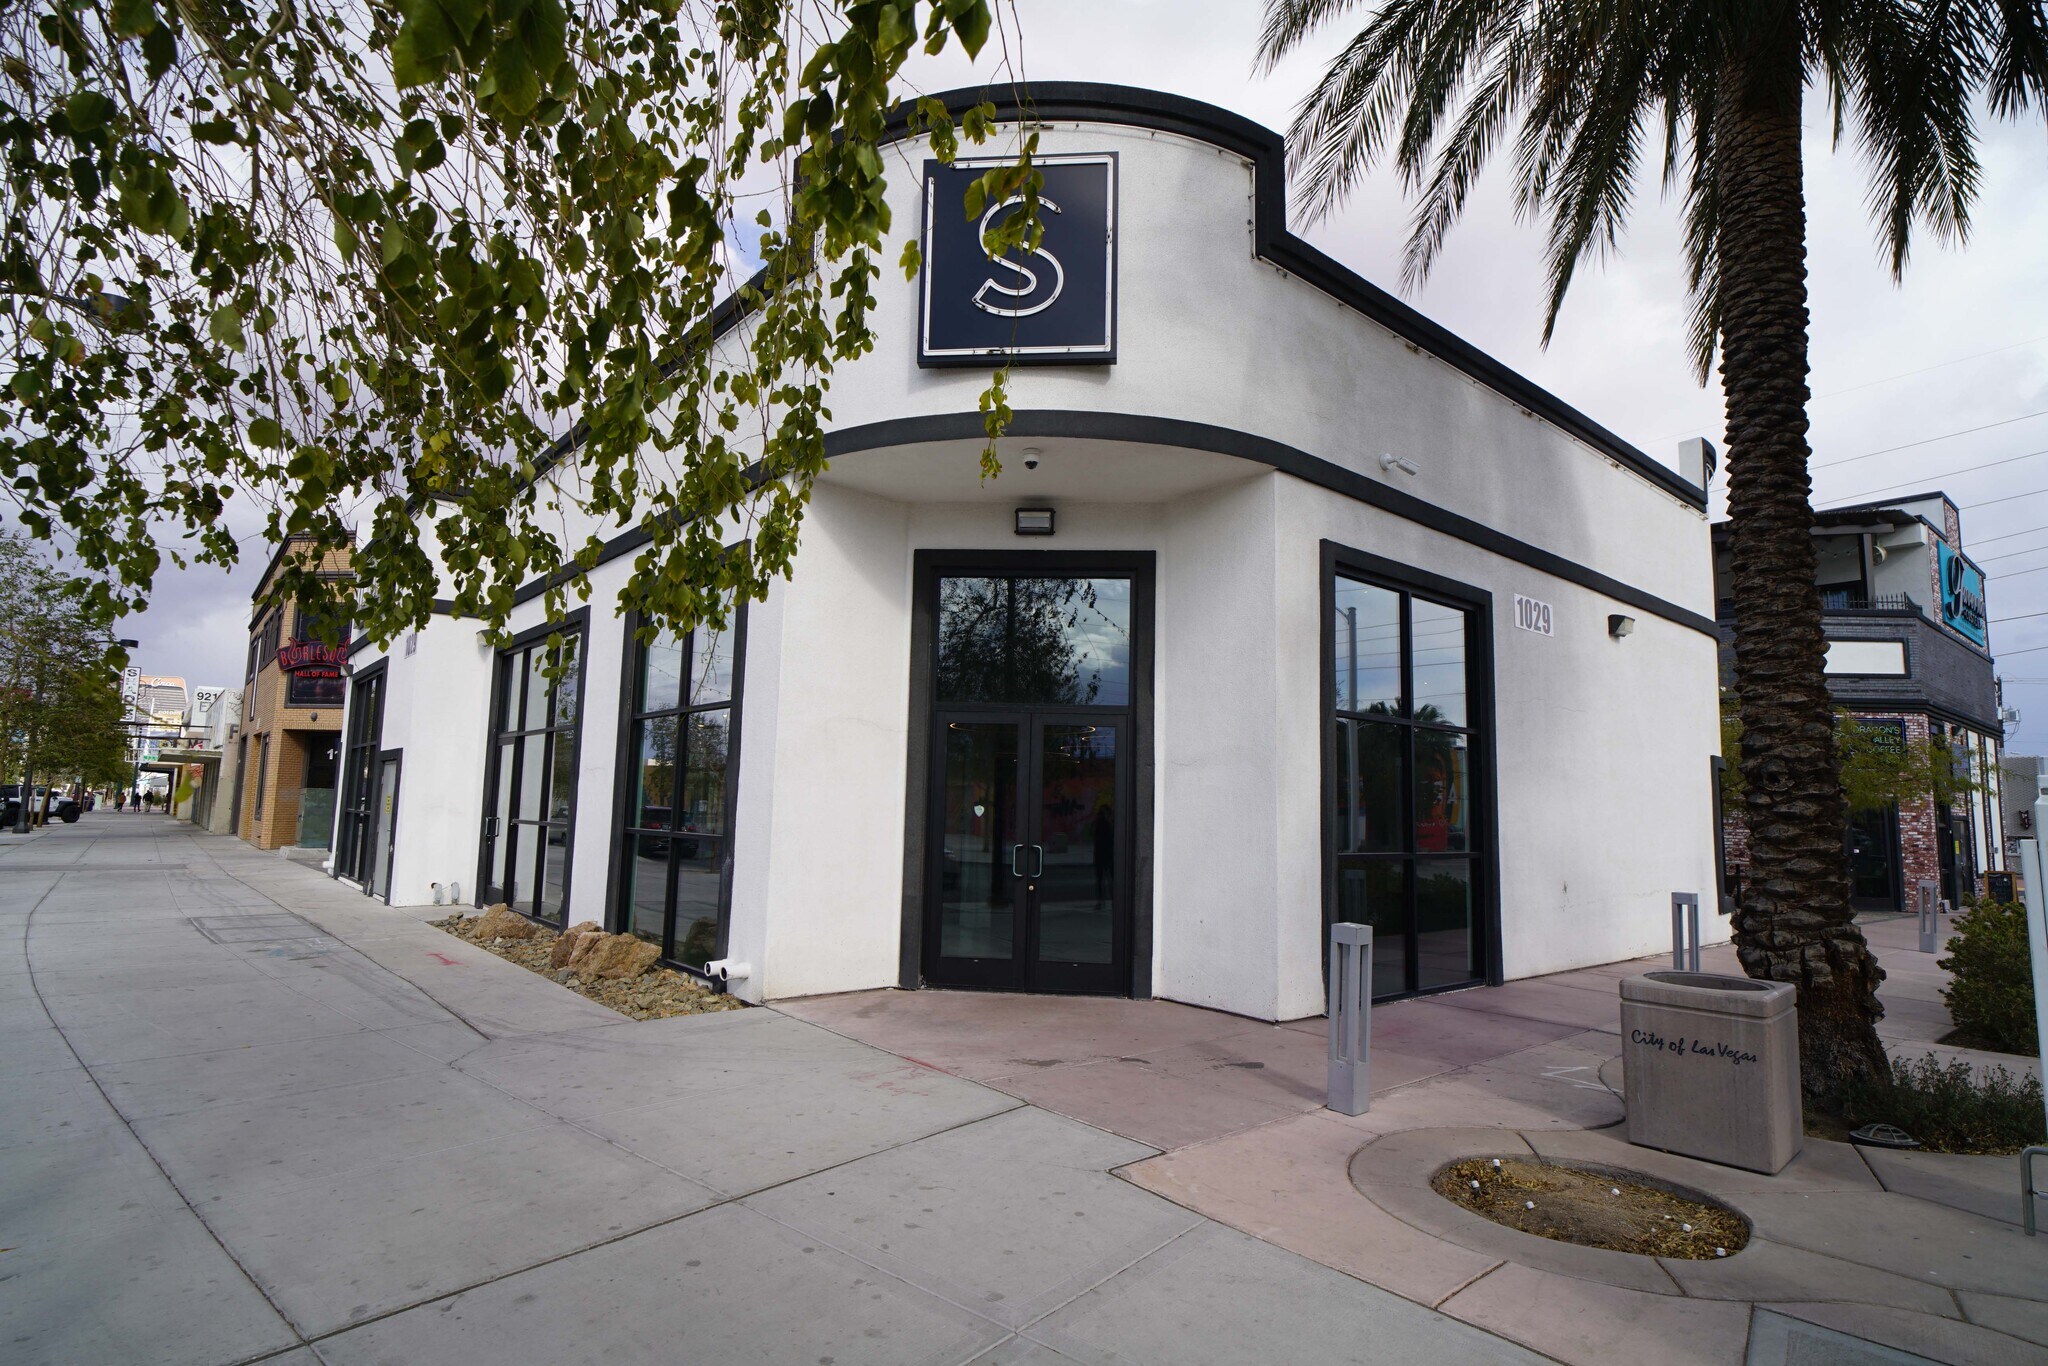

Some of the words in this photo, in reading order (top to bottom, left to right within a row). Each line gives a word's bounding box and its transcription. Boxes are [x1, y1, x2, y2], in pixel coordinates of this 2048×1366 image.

[972, 195, 1064, 317] S
[1517, 597, 1550, 634] 1029
[280, 637, 350, 665] BURLESQU
[197, 692, 217, 701] 921
[1631, 1029, 1664, 1050] City
[1669, 1037, 1685, 1055] of
[1691, 1040, 1715, 1056] Las
[1717, 1042, 1757, 1065] Vegas
